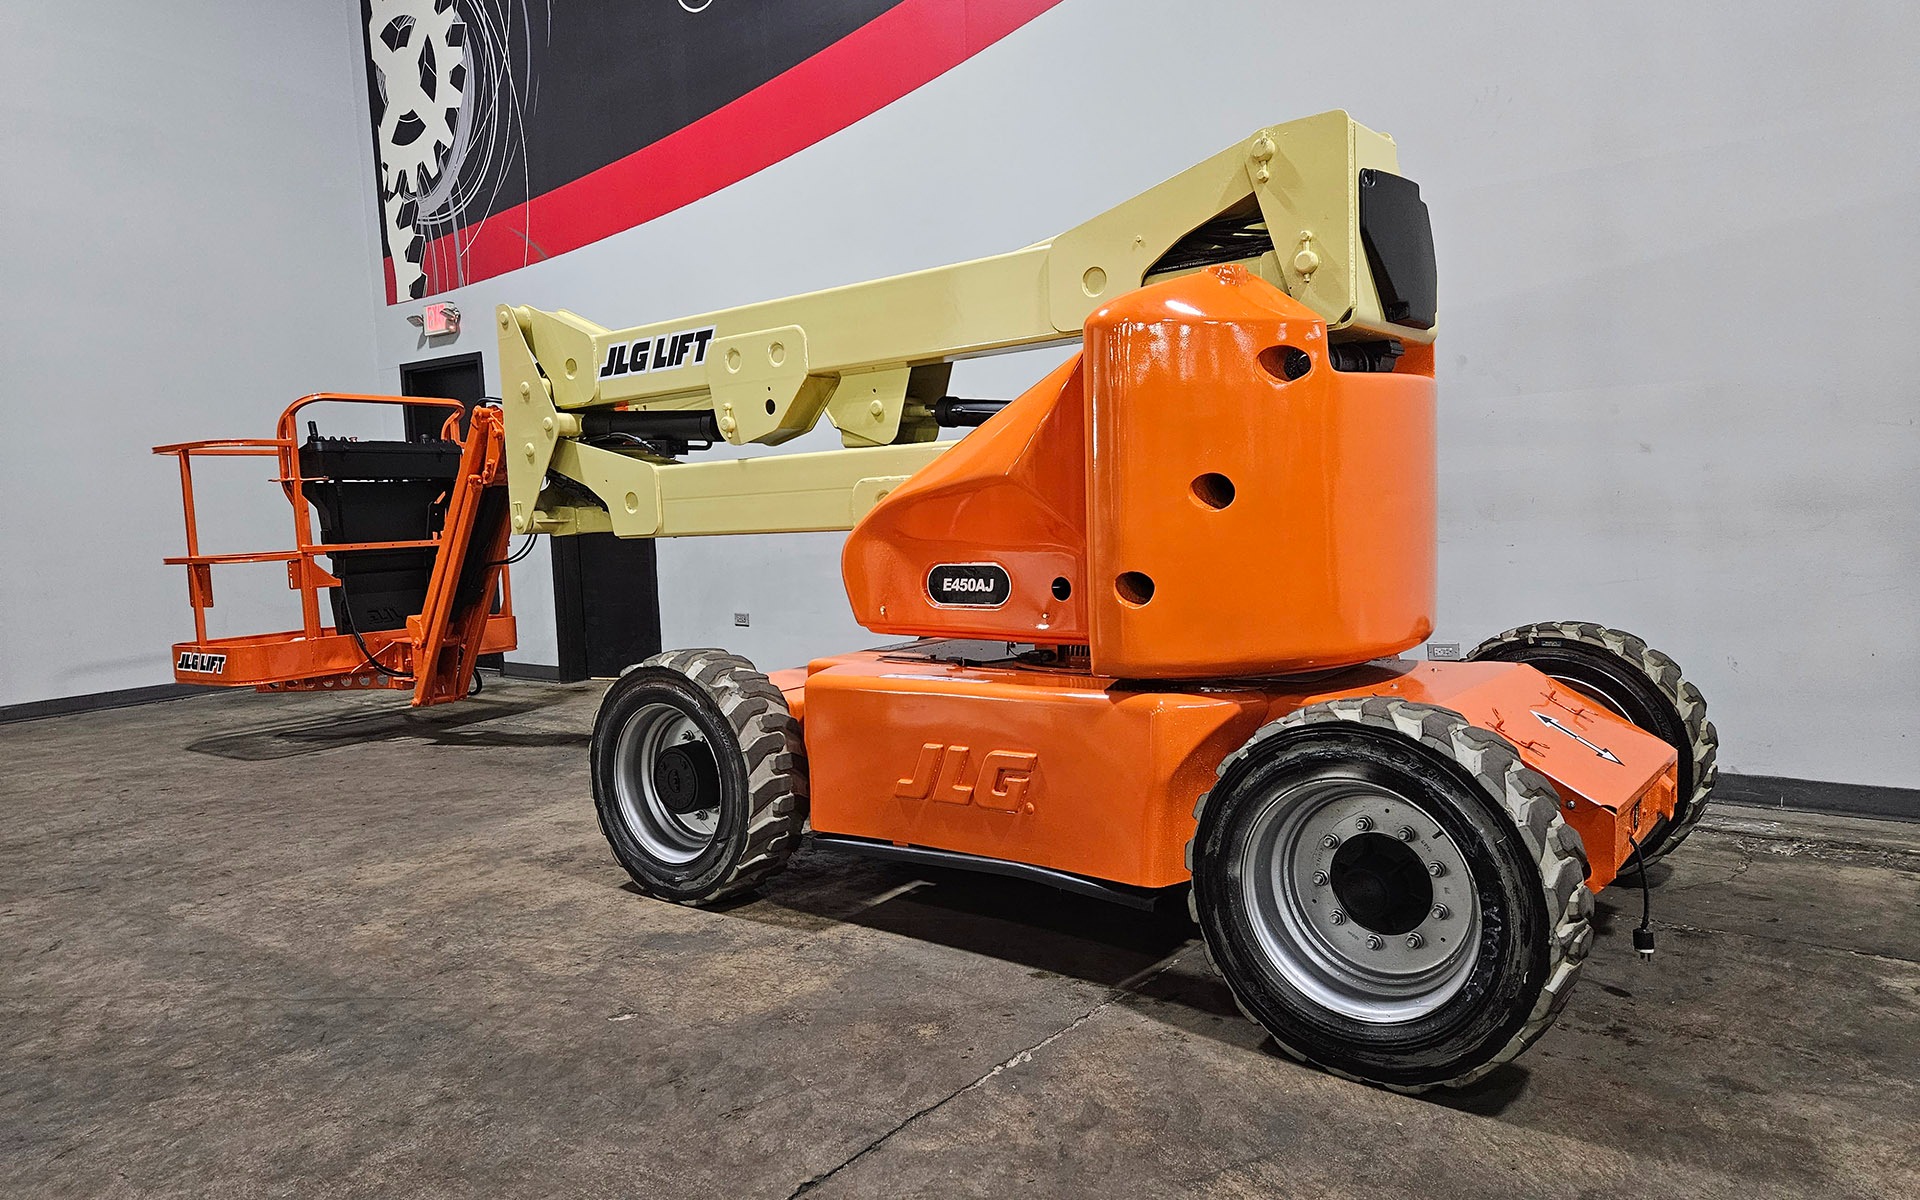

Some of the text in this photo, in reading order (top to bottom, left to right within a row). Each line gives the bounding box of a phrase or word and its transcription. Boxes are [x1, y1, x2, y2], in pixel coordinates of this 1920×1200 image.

[600, 329, 714, 377] JLG LIFT
[943, 578, 995, 592] E450AJ
[177, 653, 226, 673] JLG LIFT
